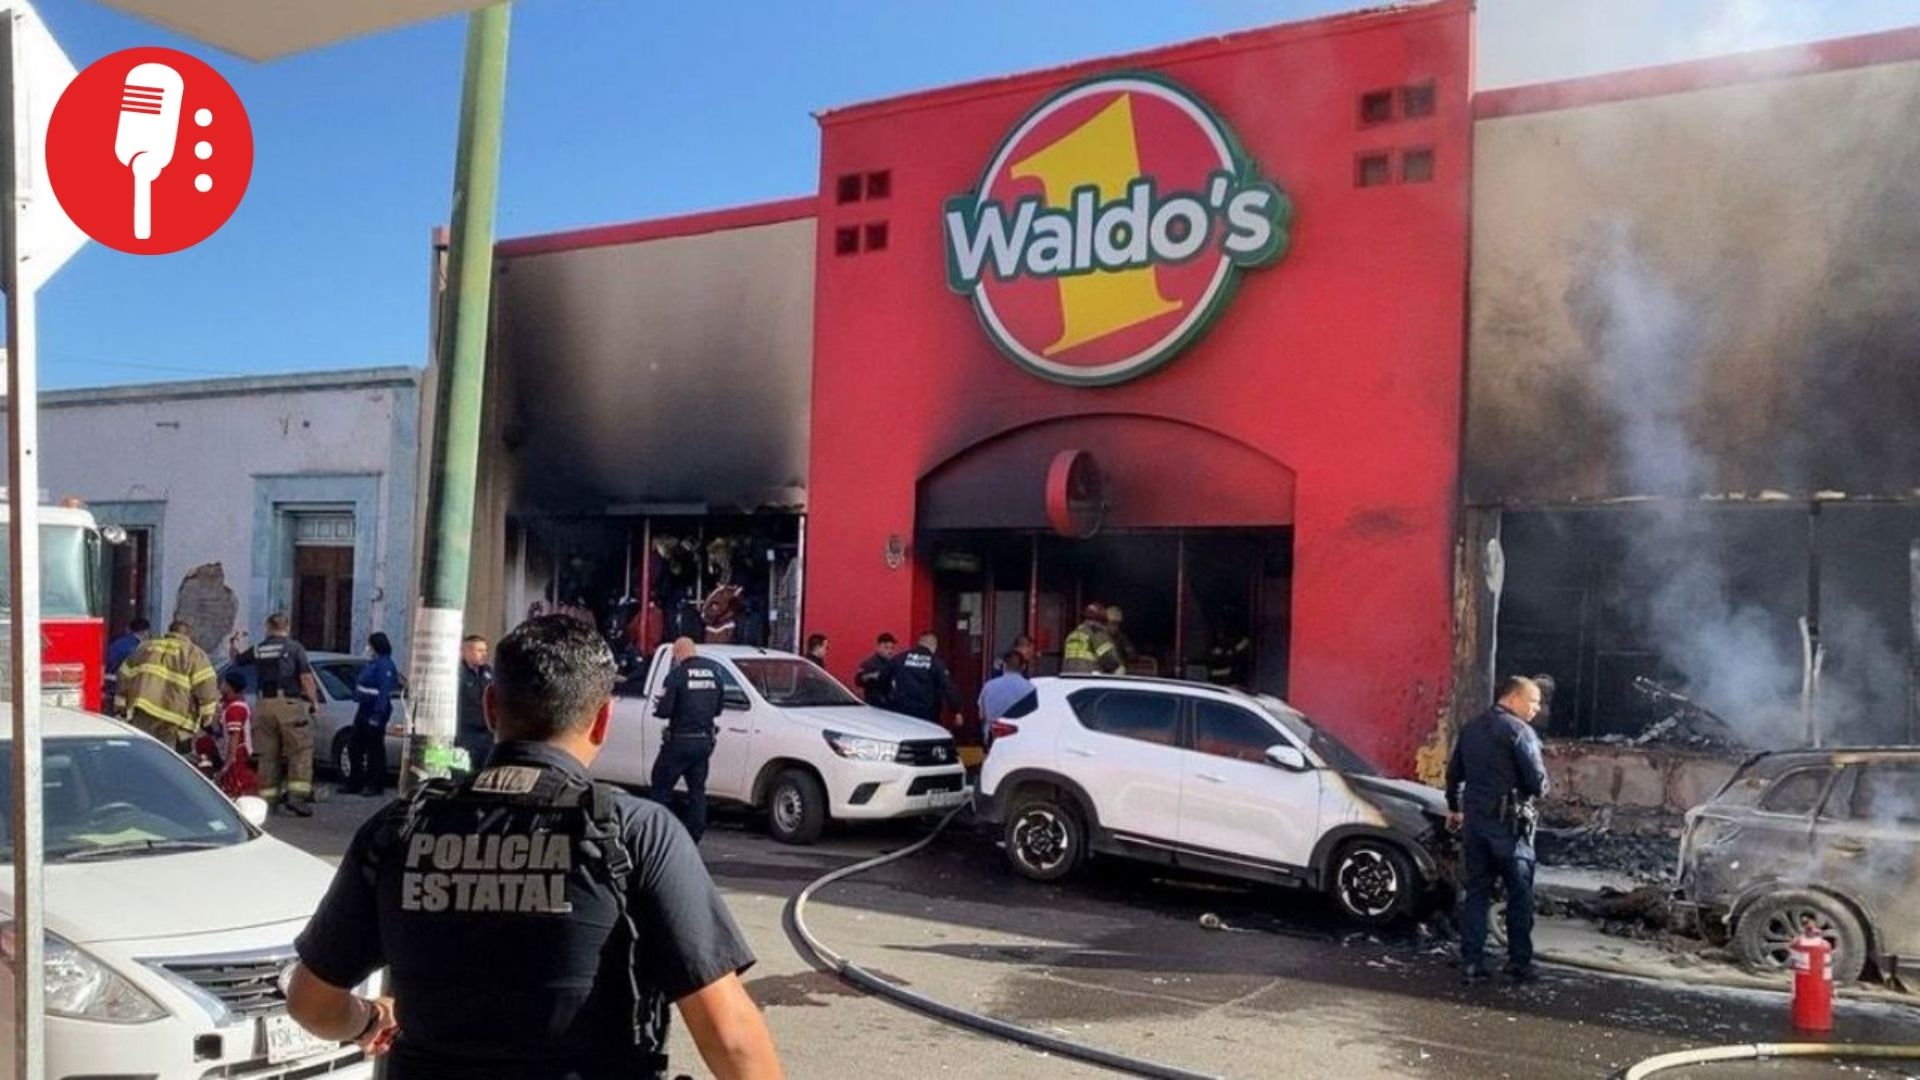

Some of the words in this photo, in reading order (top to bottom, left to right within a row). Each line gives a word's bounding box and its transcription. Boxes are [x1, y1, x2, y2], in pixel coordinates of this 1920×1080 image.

[946, 176, 1272, 281] Waldo's
[405, 828, 572, 871] POLICÍA
[402, 871, 573, 913] ESTATAL
